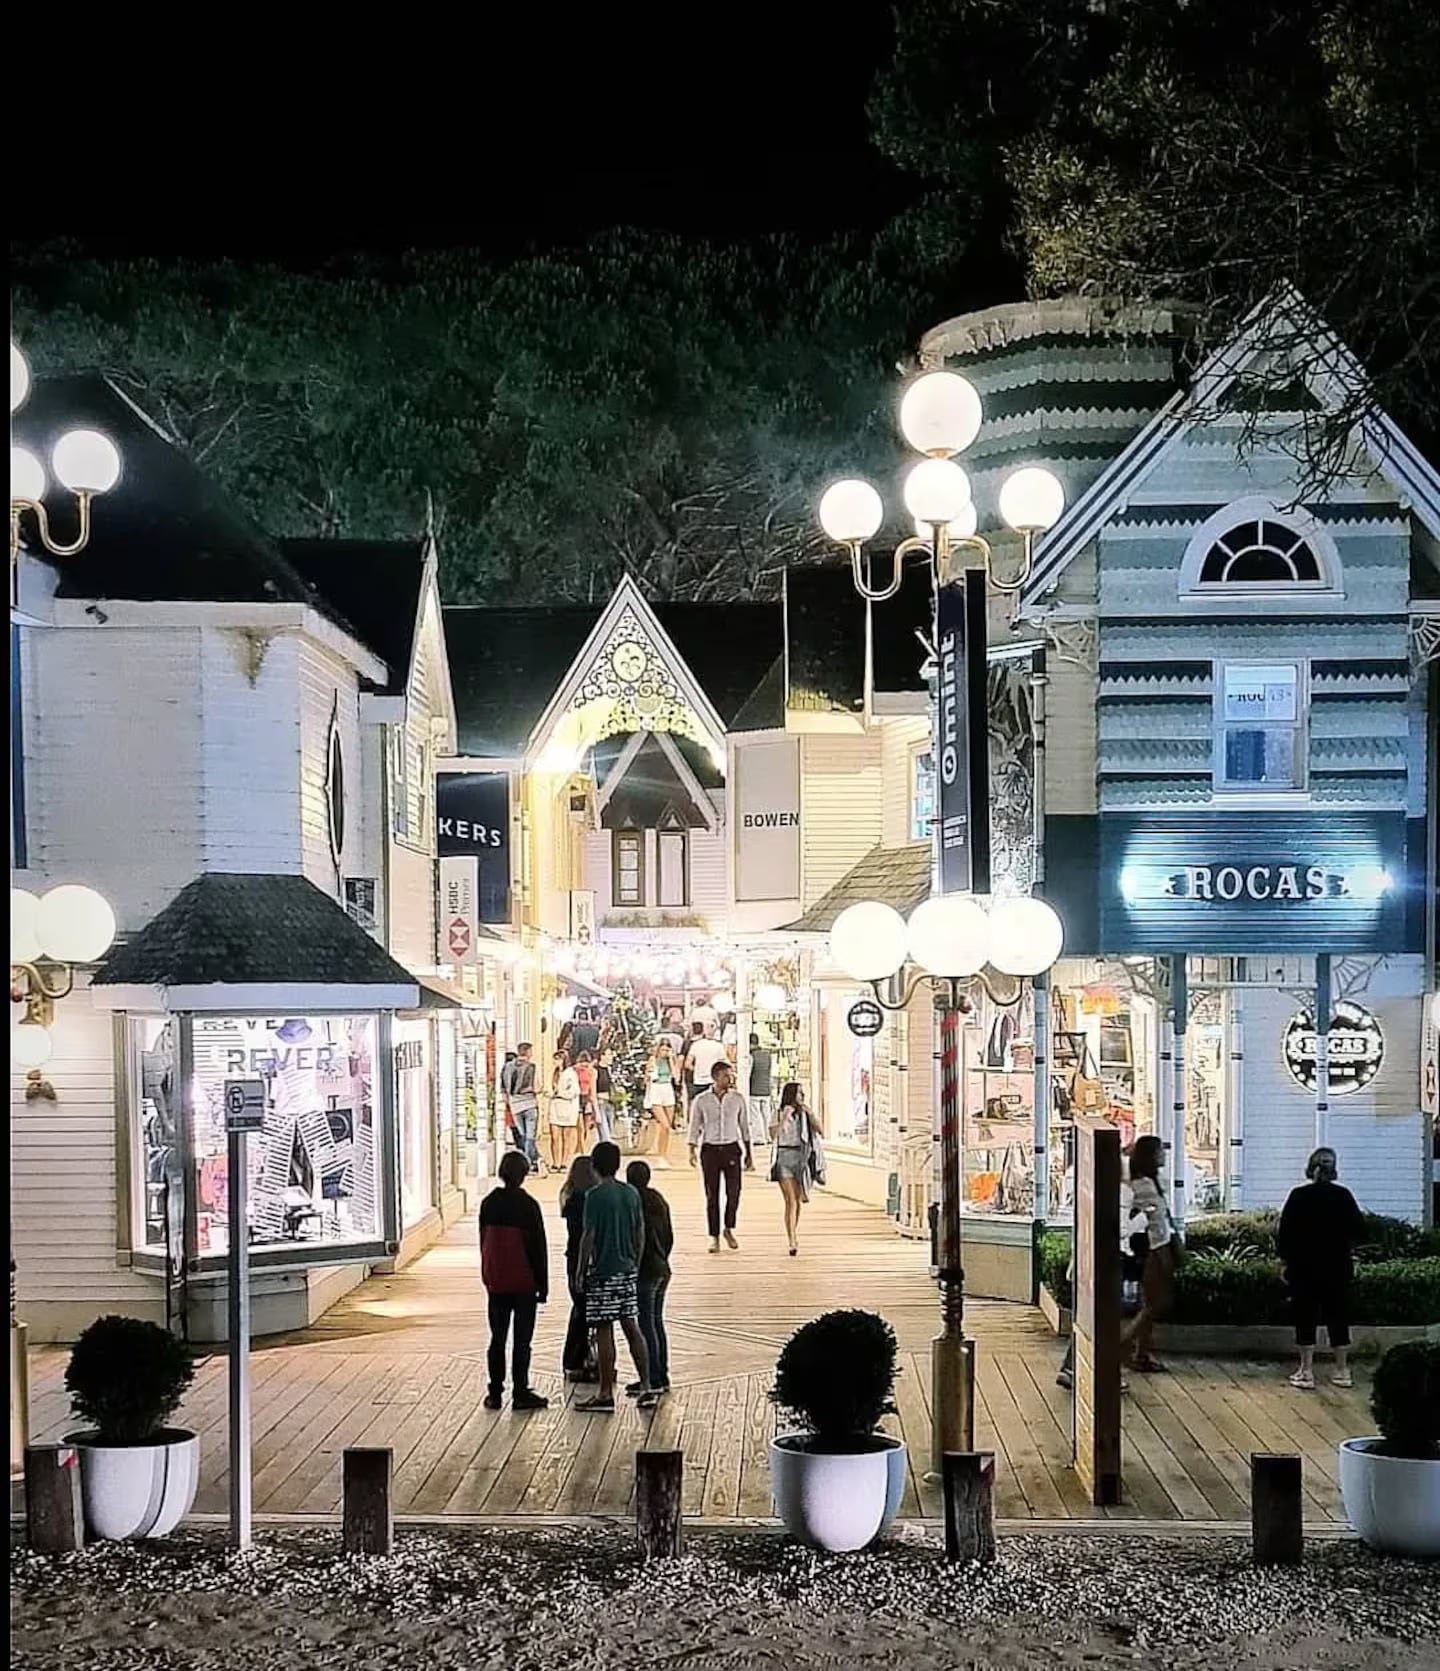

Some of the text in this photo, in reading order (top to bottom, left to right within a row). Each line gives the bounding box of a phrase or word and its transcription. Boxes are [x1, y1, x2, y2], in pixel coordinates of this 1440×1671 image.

[941, 632, 958, 785] Omint
[438, 816, 501, 847] KERS
[744, 813, 799, 827] BOWEN
[1185, 866, 1329, 900] ROCAS
[1303, 1038, 1366, 1053] RCAS
